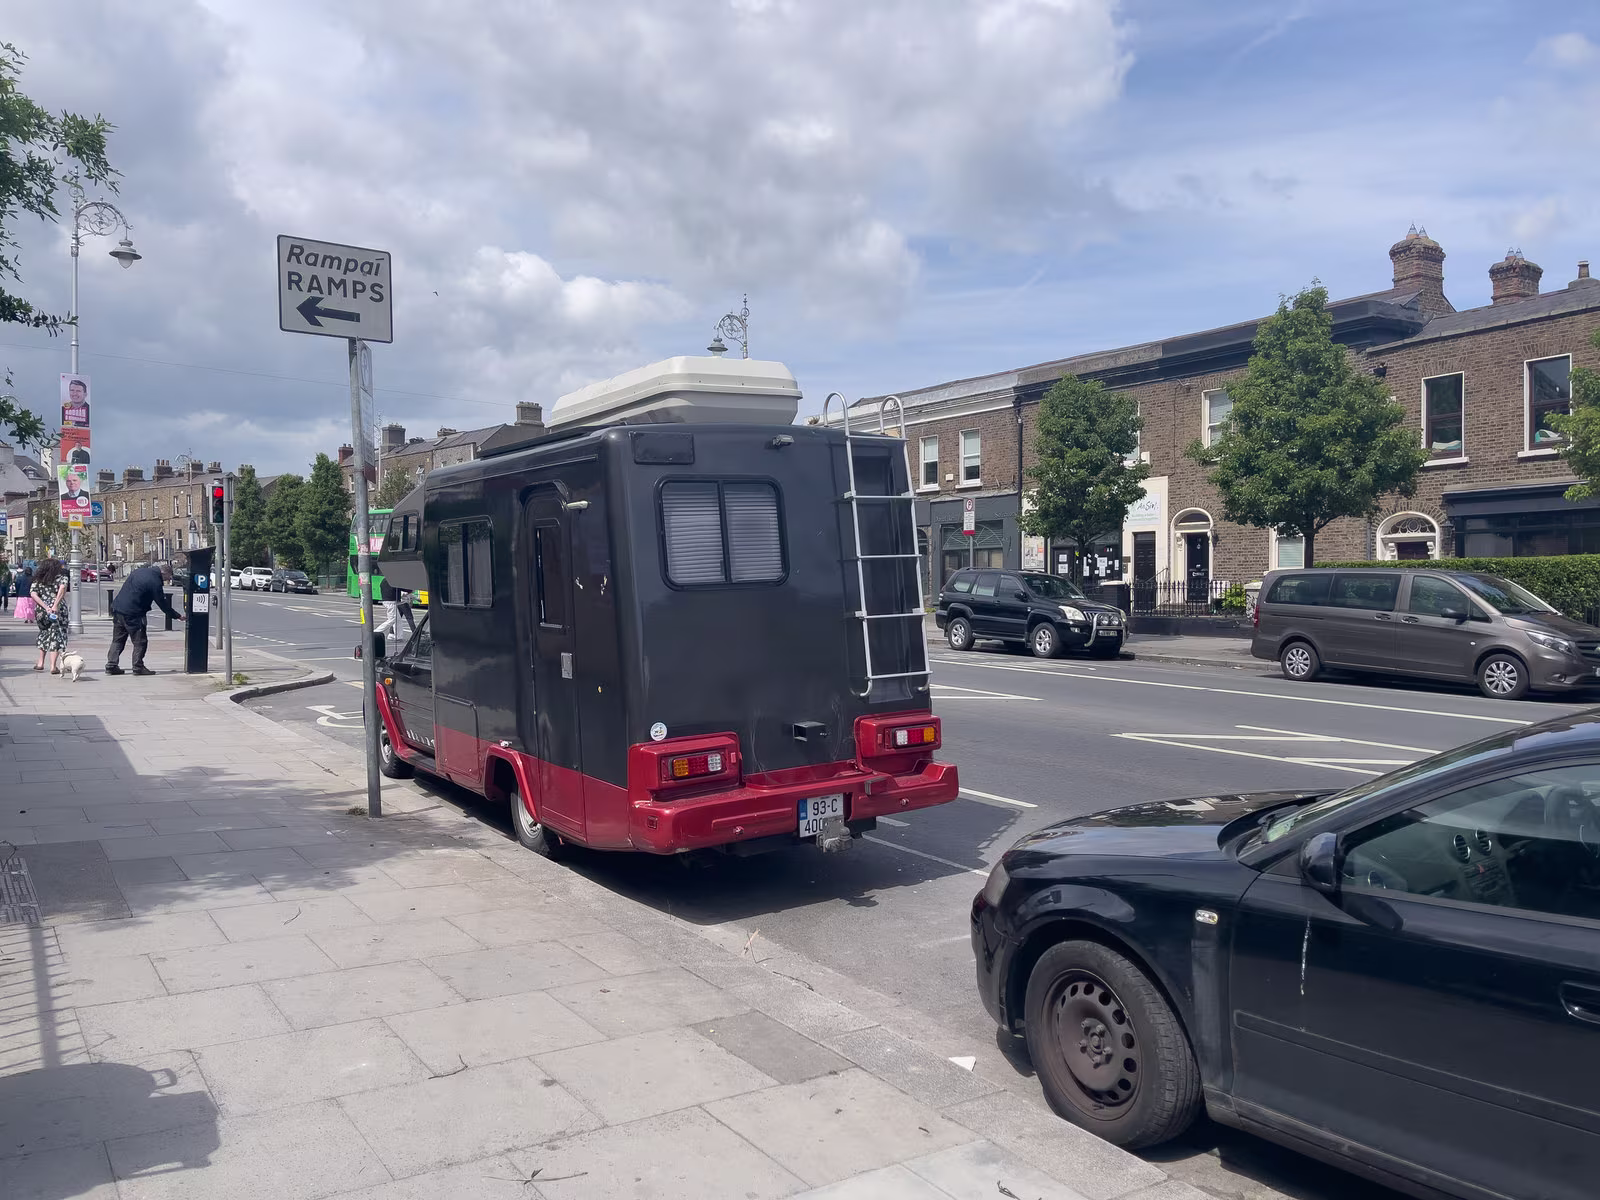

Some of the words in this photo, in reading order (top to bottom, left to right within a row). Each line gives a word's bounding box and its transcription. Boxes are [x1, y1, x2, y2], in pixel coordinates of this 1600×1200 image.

[286, 243, 385, 277] Rampaí
[287, 270, 385, 303] RAMPS
[812, 799, 838, 816] 93-C
